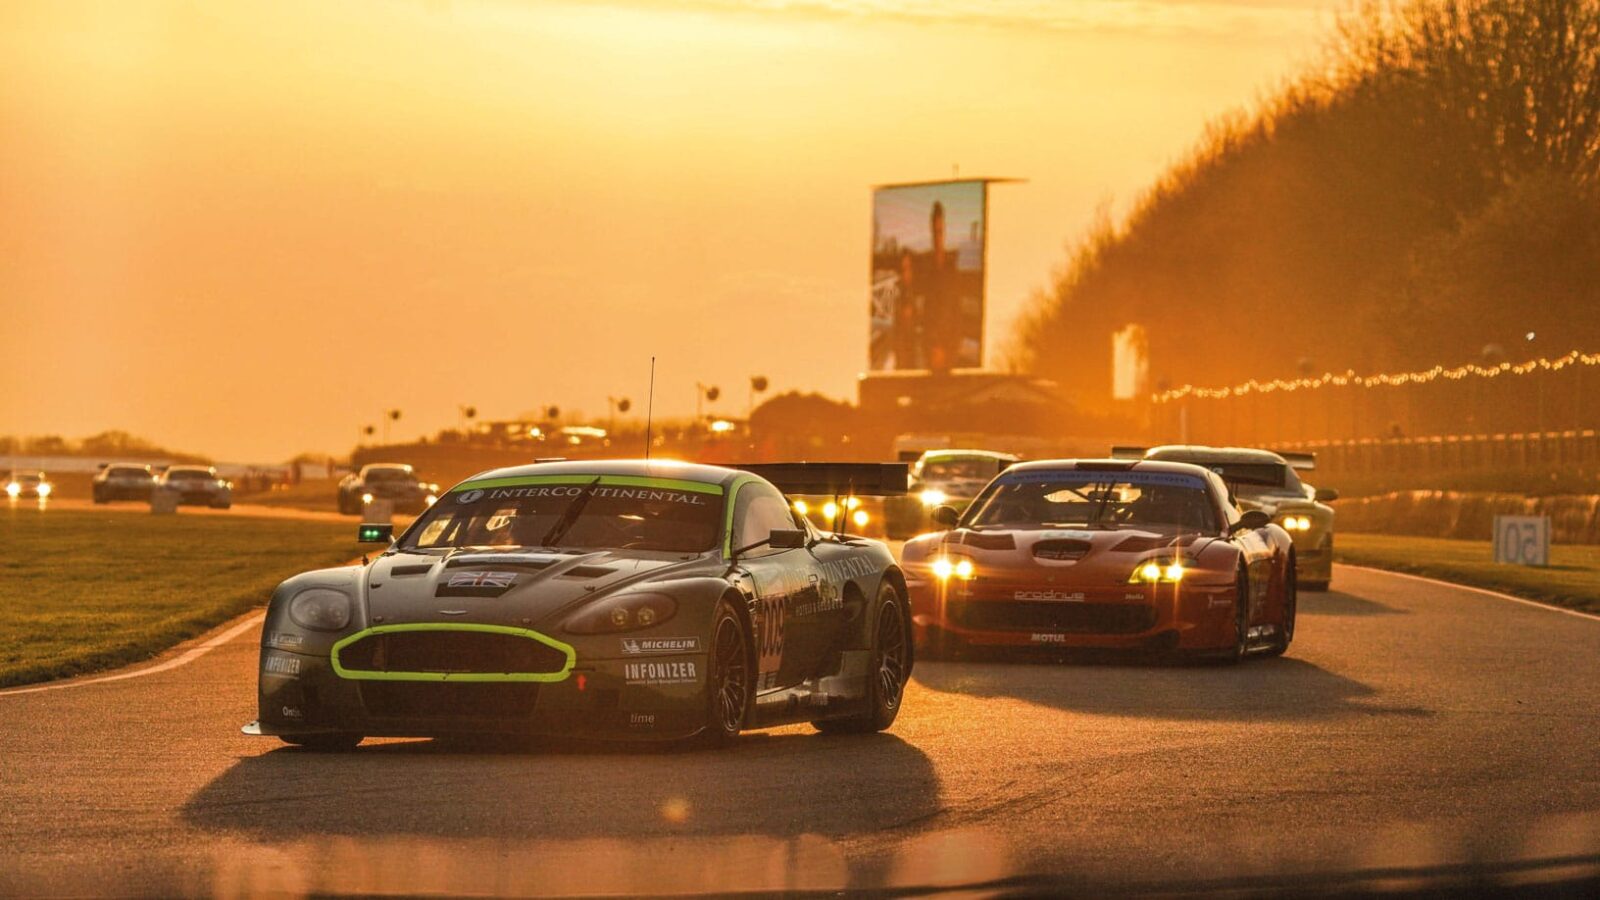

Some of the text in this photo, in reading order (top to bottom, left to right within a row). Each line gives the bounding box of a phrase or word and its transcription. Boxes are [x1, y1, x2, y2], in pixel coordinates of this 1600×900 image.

[1031, 633, 1066, 642] MOTUL
[642, 640, 696, 649] MICHELIN
[625, 662, 696, 679] INFONIZER
